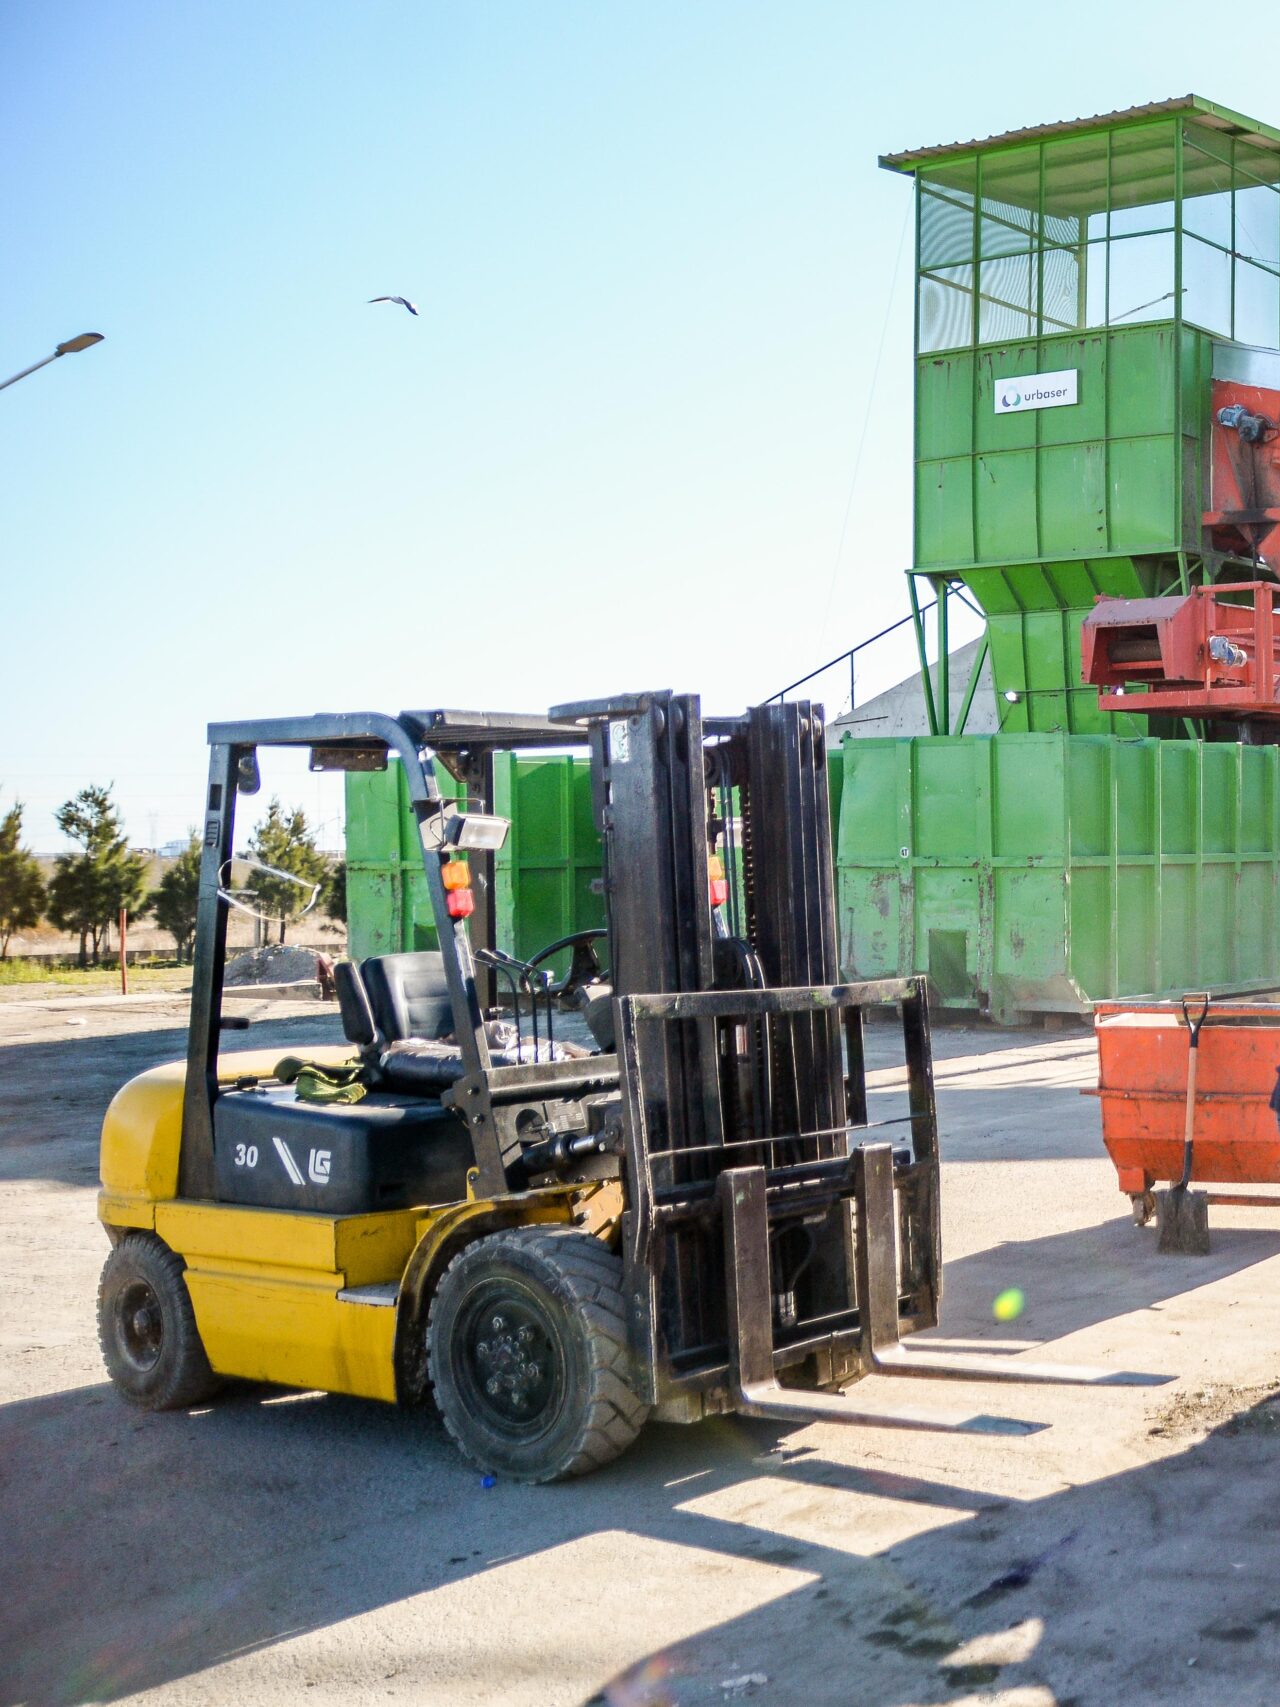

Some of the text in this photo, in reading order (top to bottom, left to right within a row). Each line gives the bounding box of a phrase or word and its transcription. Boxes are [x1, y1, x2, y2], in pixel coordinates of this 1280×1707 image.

[1024, 388, 1068, 402] urbaser
[234, 1143, 332, 1184] 30 LG
